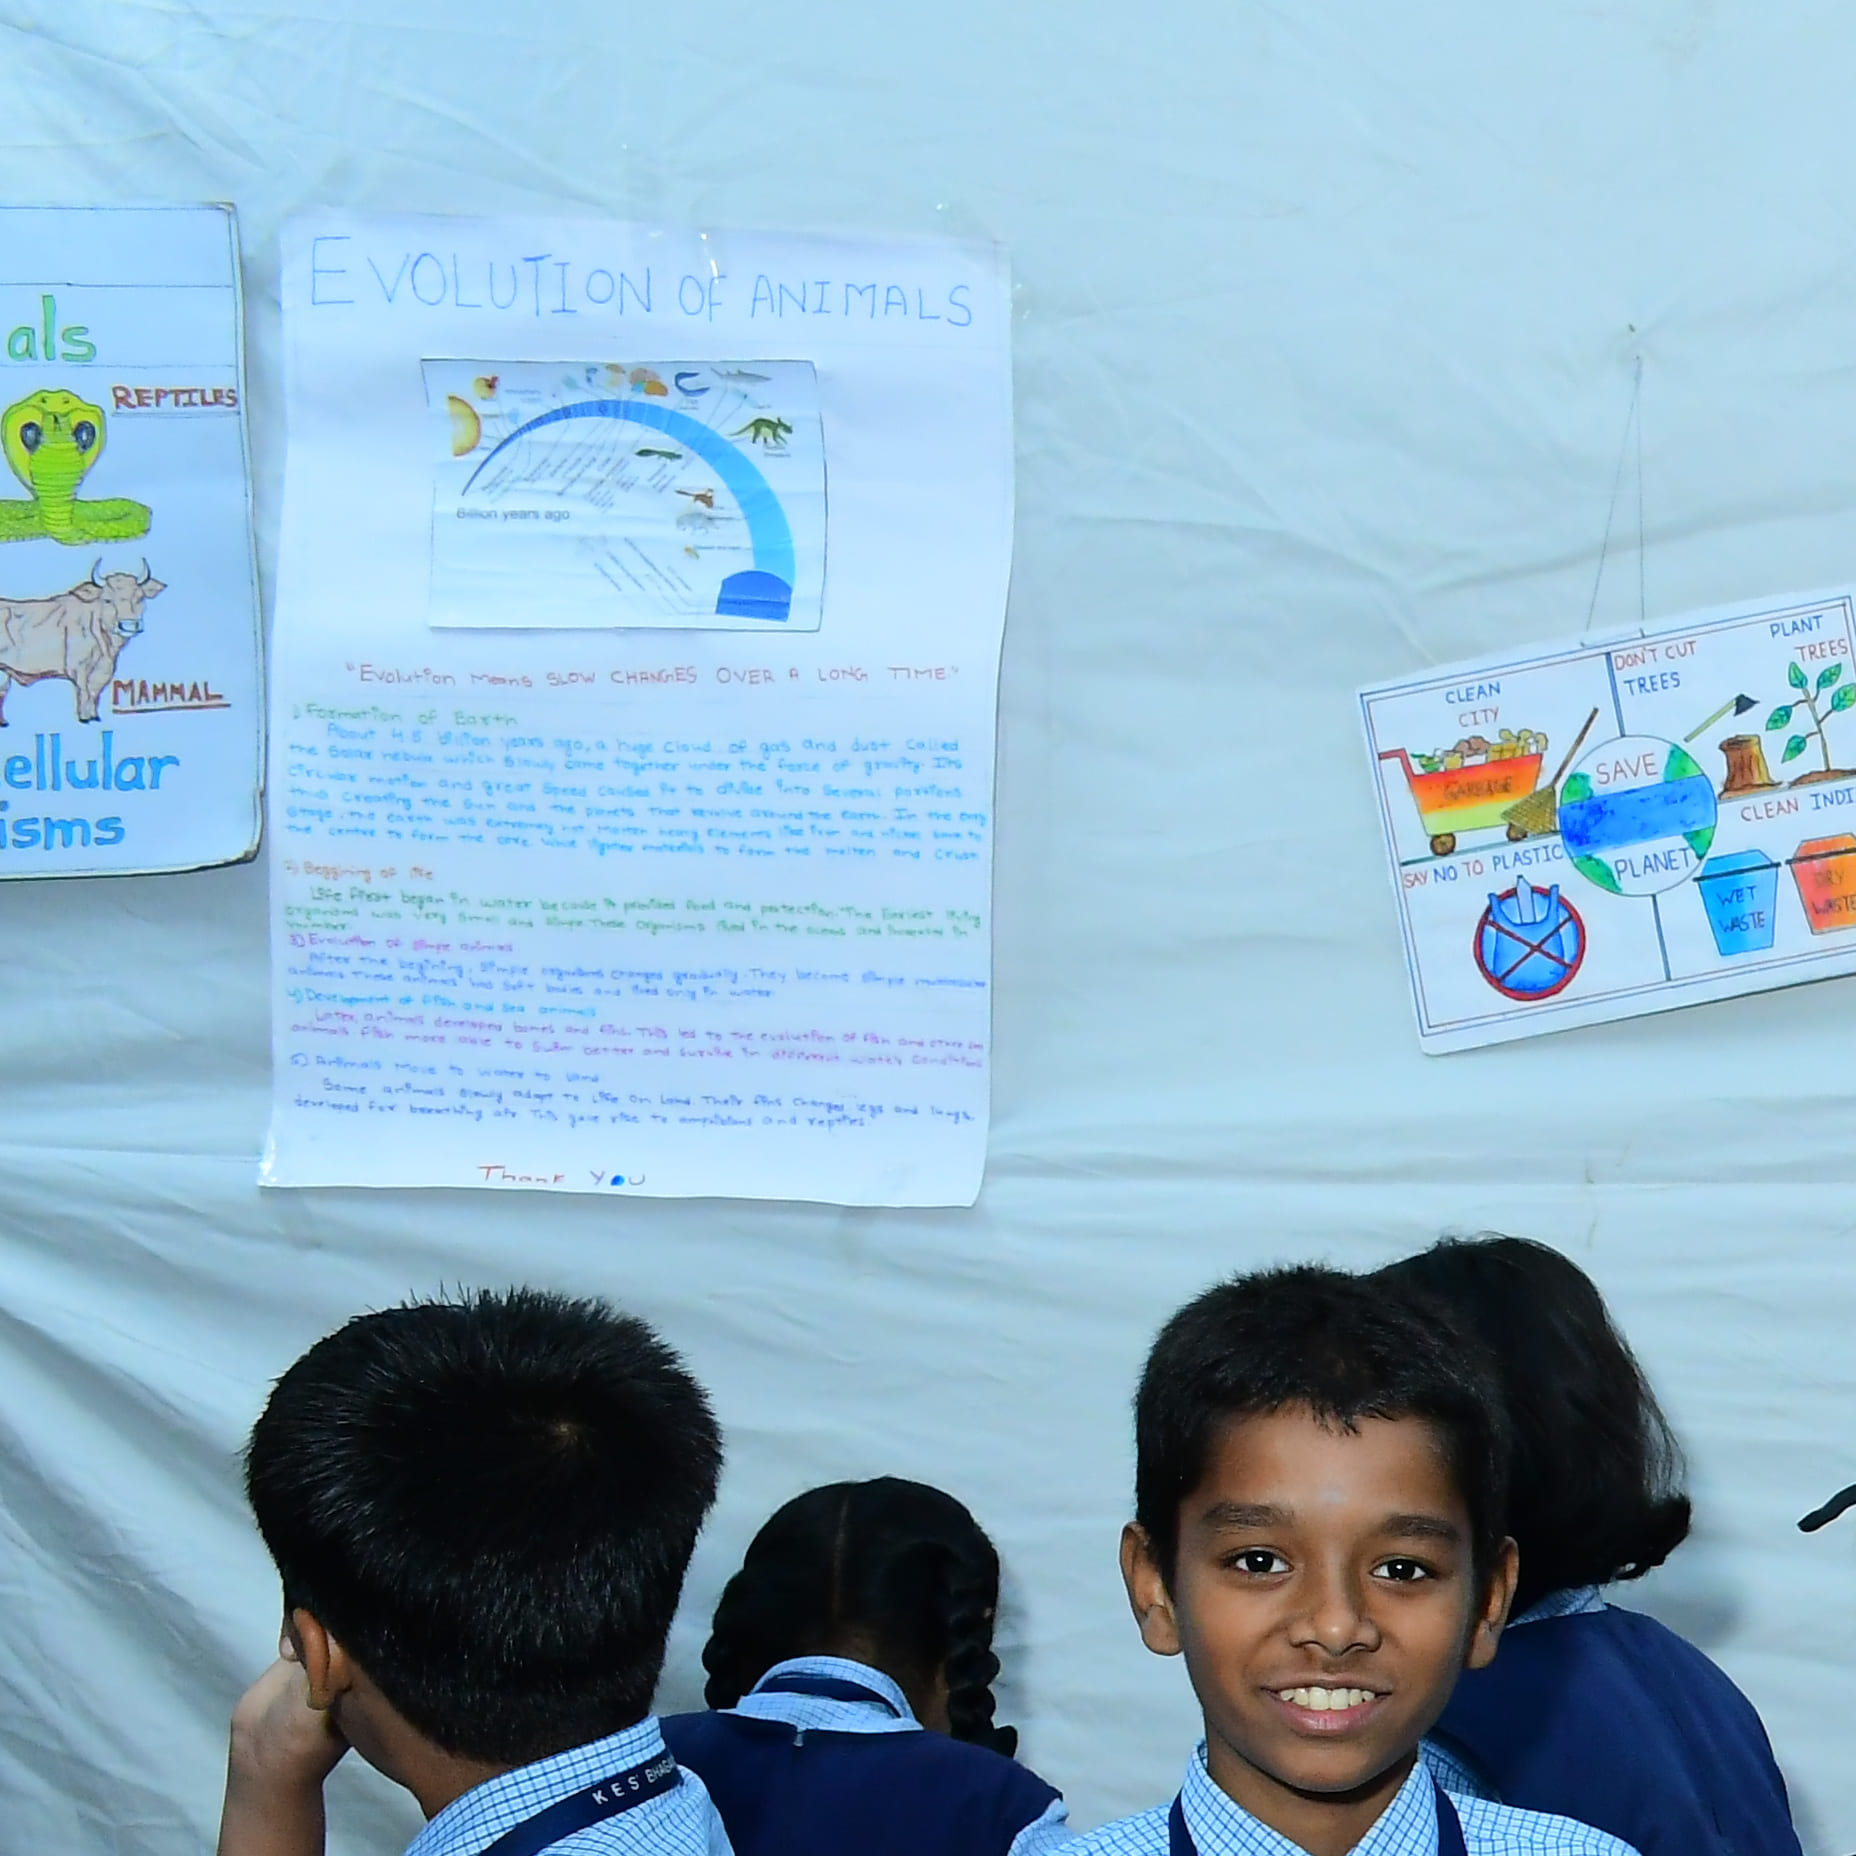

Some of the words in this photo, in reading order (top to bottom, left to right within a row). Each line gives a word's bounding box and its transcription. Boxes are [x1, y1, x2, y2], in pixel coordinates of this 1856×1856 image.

[312, 235, 652, 316] EVOLUTION
[678, 274, 724, 322] OF
[751, 274, 973, 327] ANIMALS
[7, 294, 97, 363] als
[112, 385, 237, 409] REPTILES
[1770, 615, 1823, 638] PLANT
[1614, 645, 1658, 671] DON'T
[1664, 642, 1697, 661] CUT
[1795, 640, 1848, 661] TREES
[546, 668, 596, 686] SLOW
[610, 666, 697, 686] CHANGES
[716, 667, 774, 685] OVER
[818, 666, 868, 684] LONG
[1623, 672, 1681, 696] TREES
[114, 679, 223, 707] MAMMAL
[1446, 682, 1500, 705] CLEAN
[1458, 708, 1500, 727] CITY
[5, 730, 180, 791] ellular
[1596, 753, 1659, 785] SAVE
[1741, 798, 1799, 822] CLEAN
[1403, 870, 1429, 888] SAY
[1432, 865, 1458, 883] NO
[1462, 861, 1484, 877] TO
[1492, 845, 1563, 871] PLASTIC
[1614, 849, 1691, 880] PLANET
[1815, 869, 1843, 889] DRY
[1716, 884, 1755, 907] WET
[1719, 912, 1766, 933] WASTE
